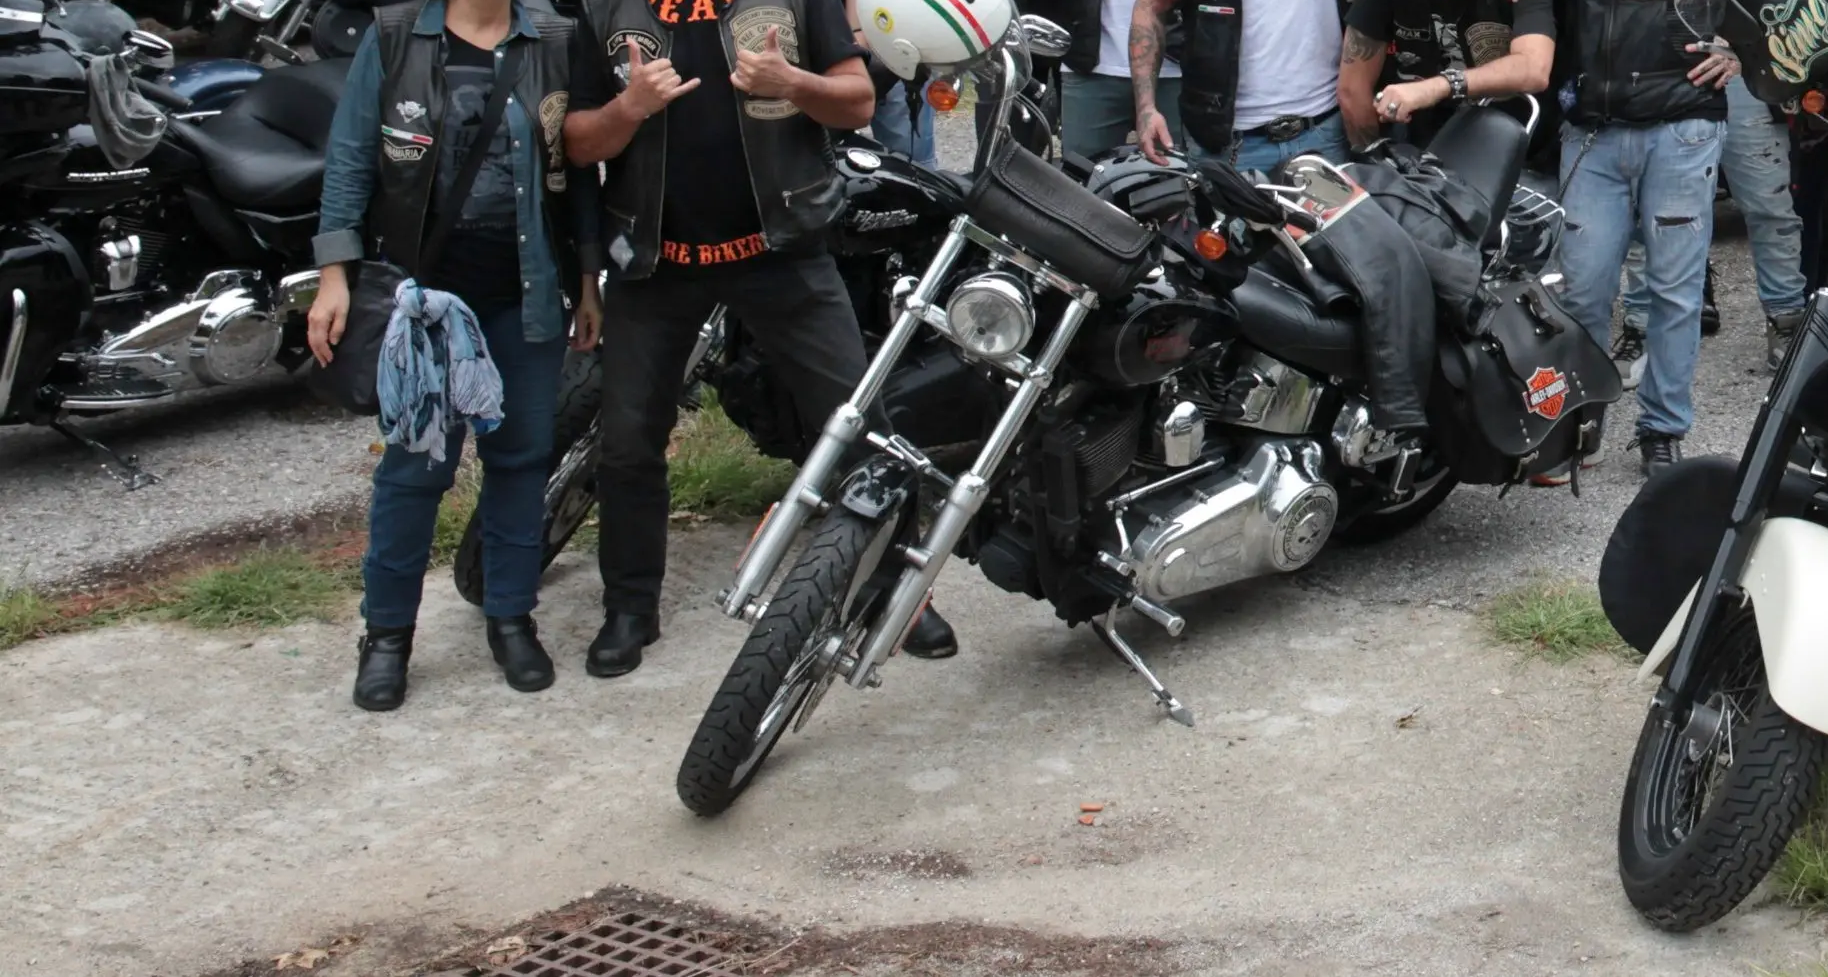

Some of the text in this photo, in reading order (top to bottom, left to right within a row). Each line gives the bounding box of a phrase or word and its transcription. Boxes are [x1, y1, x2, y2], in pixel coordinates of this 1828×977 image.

[739, 24, 791, 45] FREE CHTER
[663, 240, 692, 264] RE
